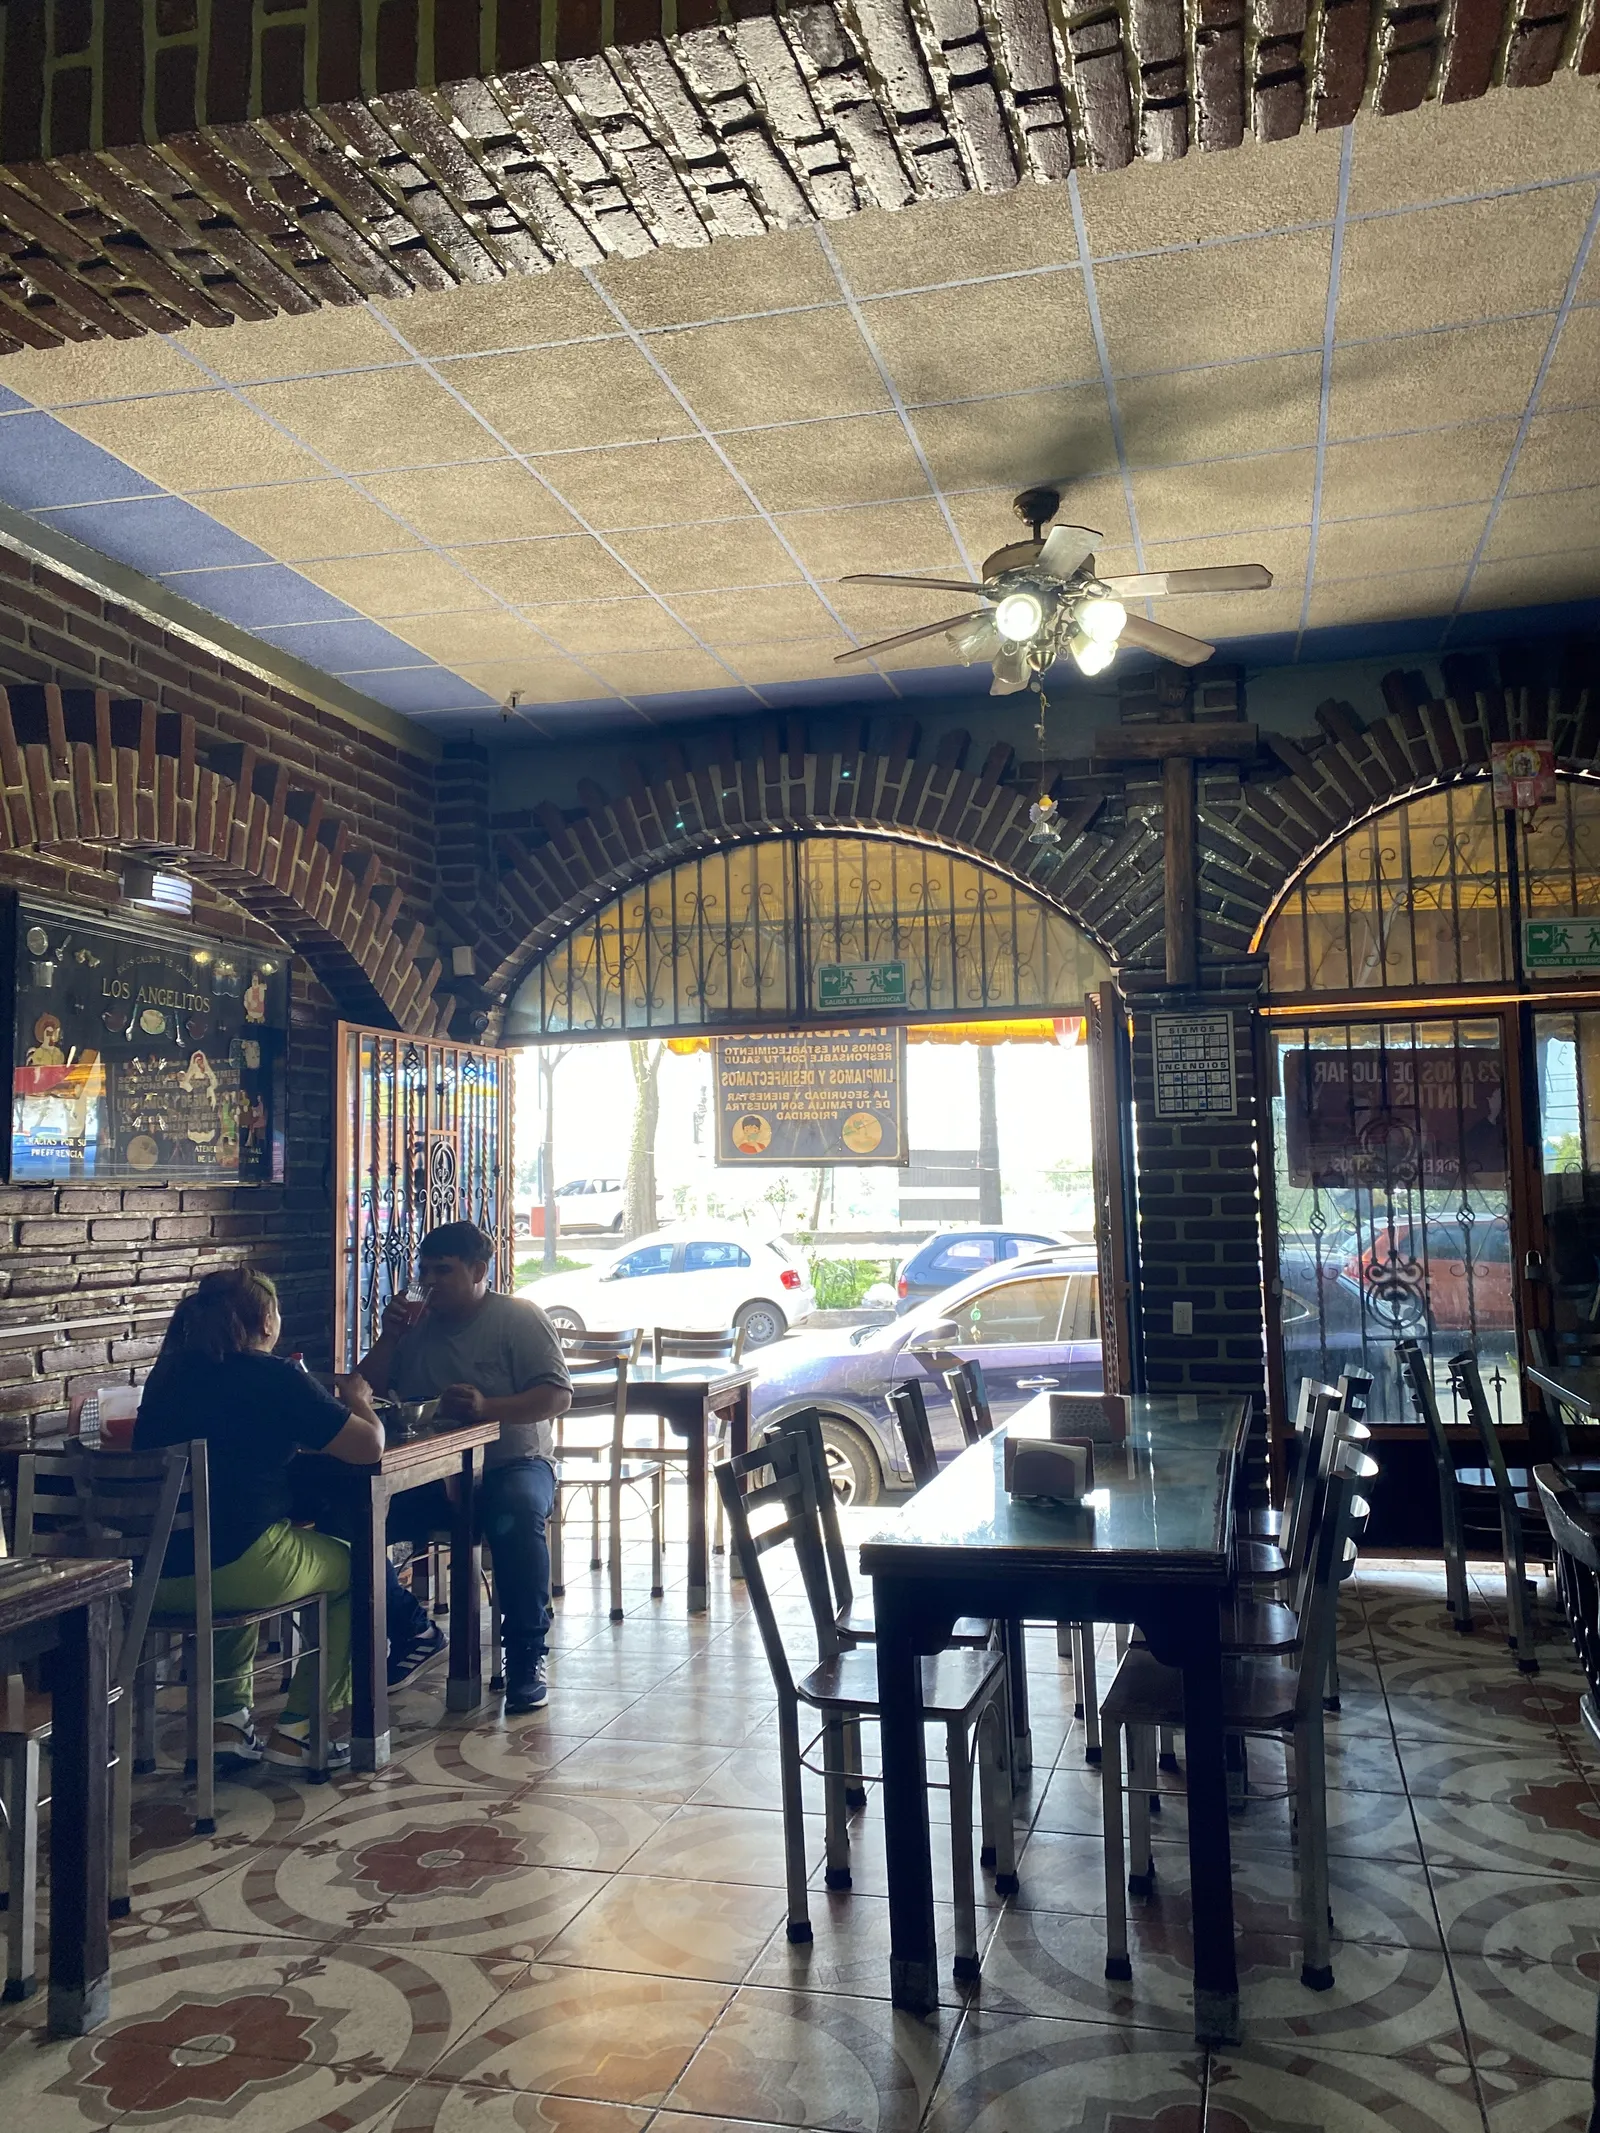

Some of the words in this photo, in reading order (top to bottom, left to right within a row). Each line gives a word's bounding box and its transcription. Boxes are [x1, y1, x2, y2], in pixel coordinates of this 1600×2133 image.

[102, 977, 131, 1000] LOS
[136, 985, 211, 1013] ANGELITOS
[860, 995, 901, 1004] EMERGENCIA
[1169, 1026, 1215, 1034] SISMOS
[1160, 1061, 1227, 1071] INCENDIOS
[24, 1138, 57, 1147] GRACIAS
[61, 1138, 74, 1146] POR
[77, 1138, 87, 1147] SU
[197, 1155, 206, 1163] DE
[208, 1155, 216, 1163] LA
